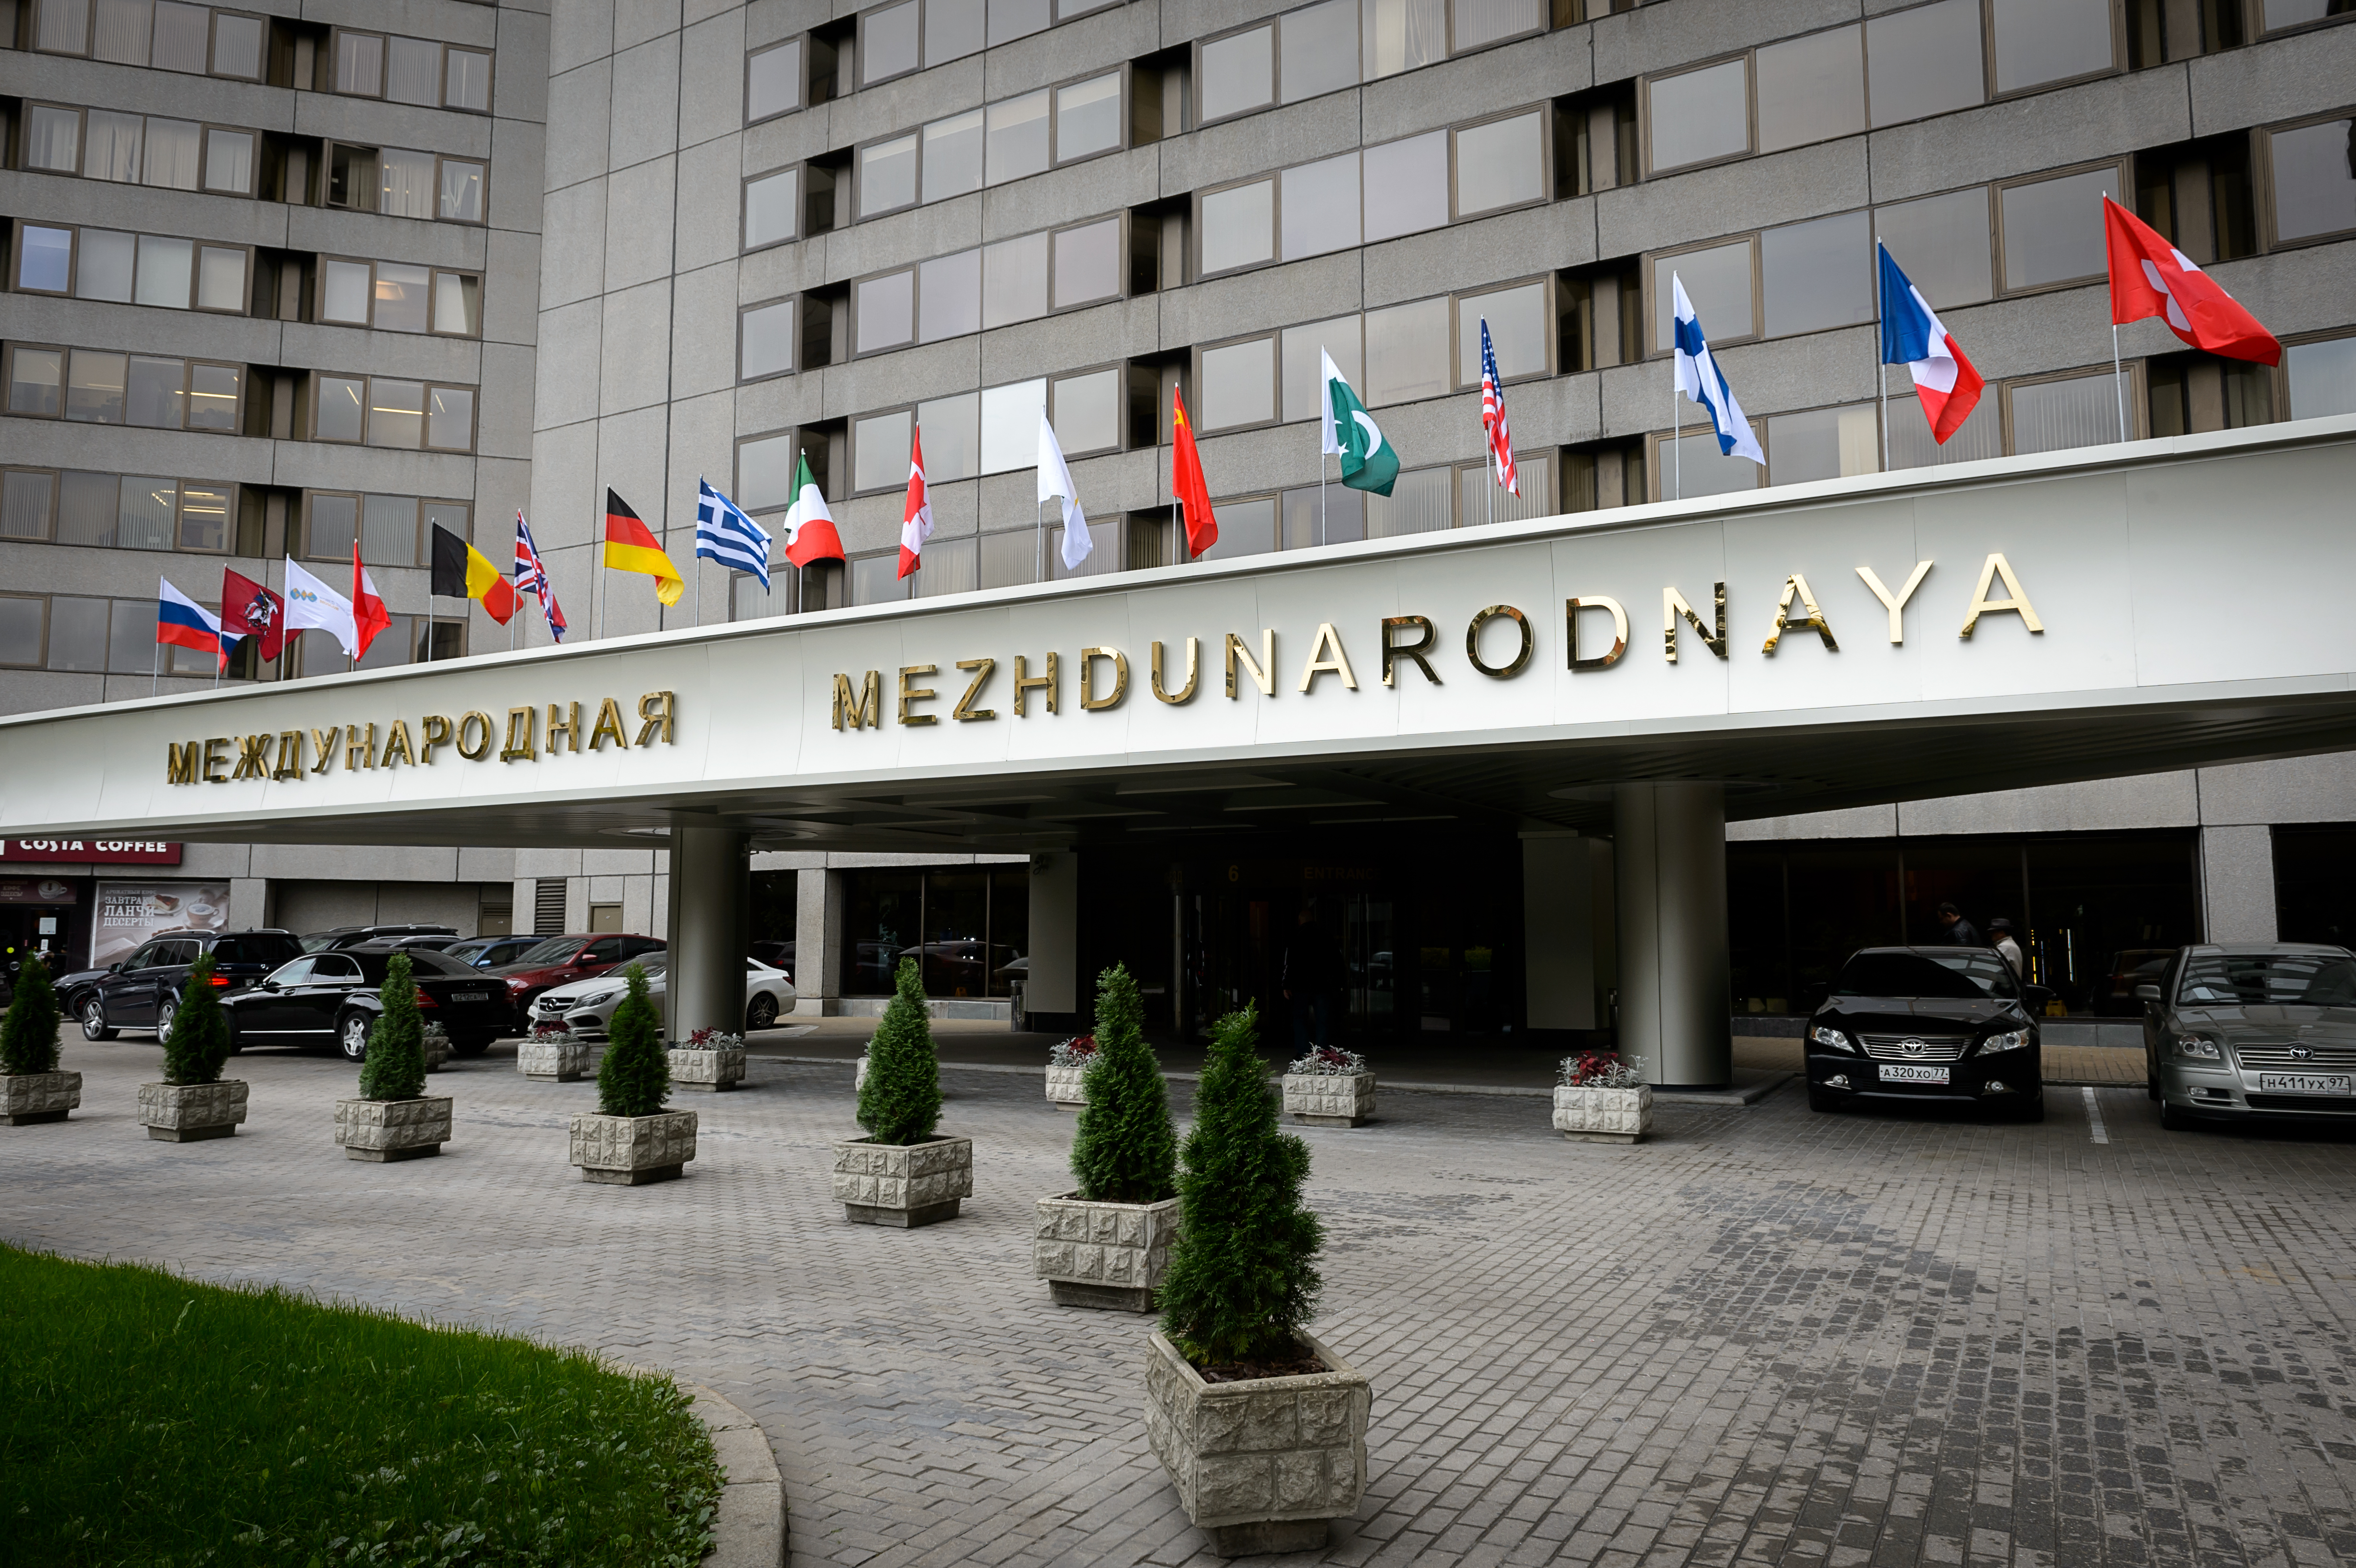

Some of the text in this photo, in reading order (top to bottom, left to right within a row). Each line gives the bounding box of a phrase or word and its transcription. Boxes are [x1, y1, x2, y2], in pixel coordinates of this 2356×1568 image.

[832, 553, 2045, 730] MEZHDUNARODNAYA
[167, 691, 673, 784] МЕЖДУНАРОДНАЯ
[96, 841, 166, 852] COFFEE
[1228, 865, 1239, 882] 6
[1304, 867, 1381, 880] ENTRANCE
[104, 905, 155, 916] ЛАНЧИ
[103, 917, 154, 927] ДЕСЕРТЫ
